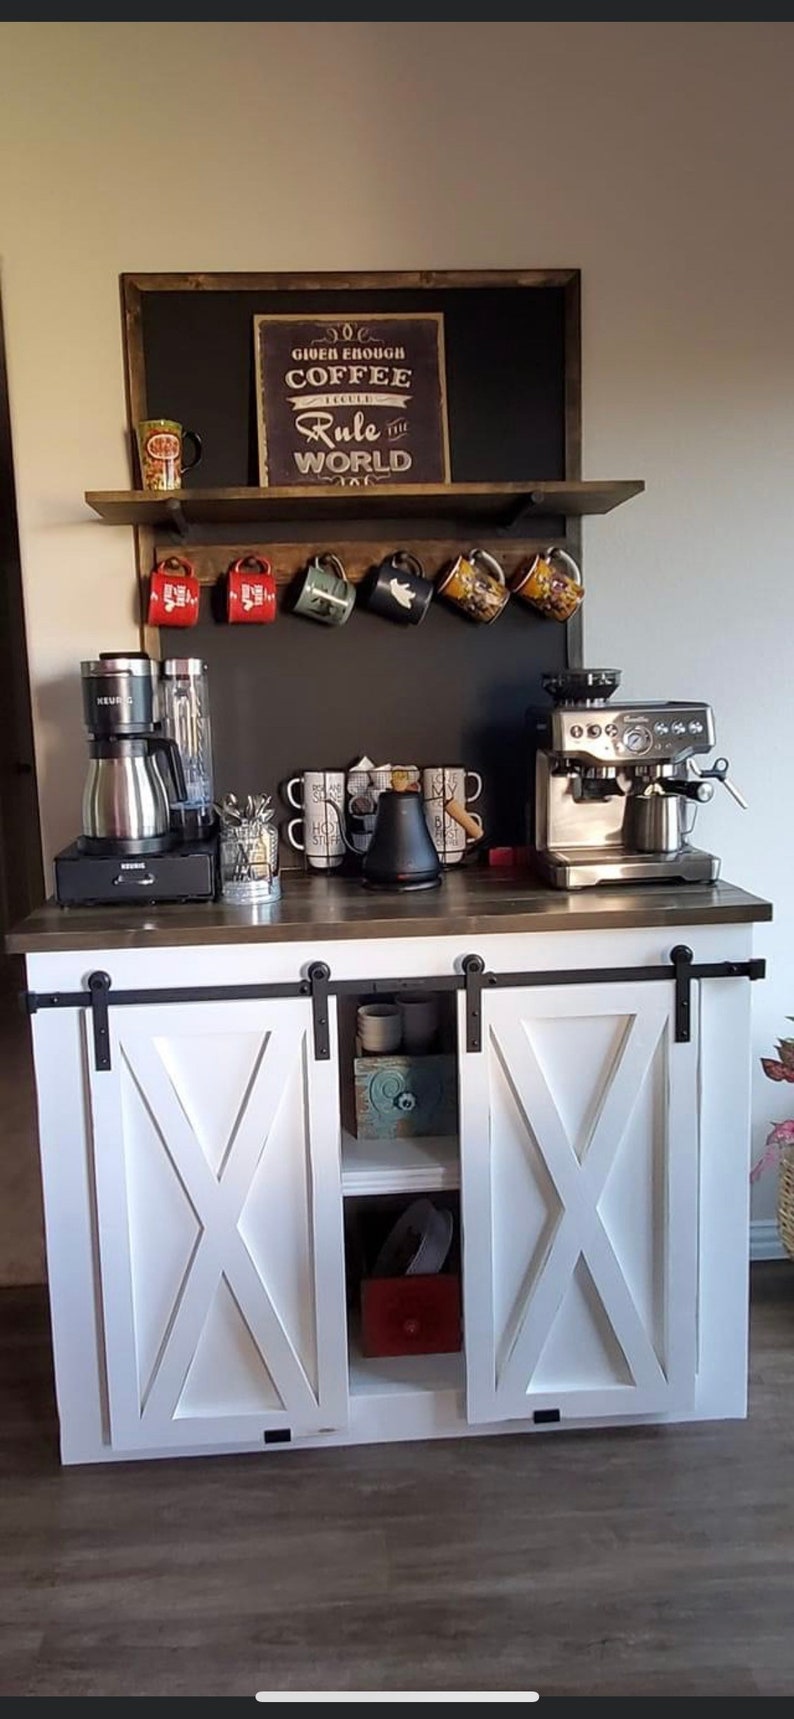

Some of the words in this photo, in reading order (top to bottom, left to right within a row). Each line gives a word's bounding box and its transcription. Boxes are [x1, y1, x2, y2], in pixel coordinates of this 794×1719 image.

[291, 347, 338, 361] GIVEN
[342, 346, 405, 360] ENOUGH
[284, 365, 412, 389] COFFEE
[294, 411, 381, 449] Rule
[293, 450, 412, 474] WORLD
[97, 696, 133, 704] KEURG
[312, 790, 342, 803] SHNE
[435, 828, 459, 839] FIST
